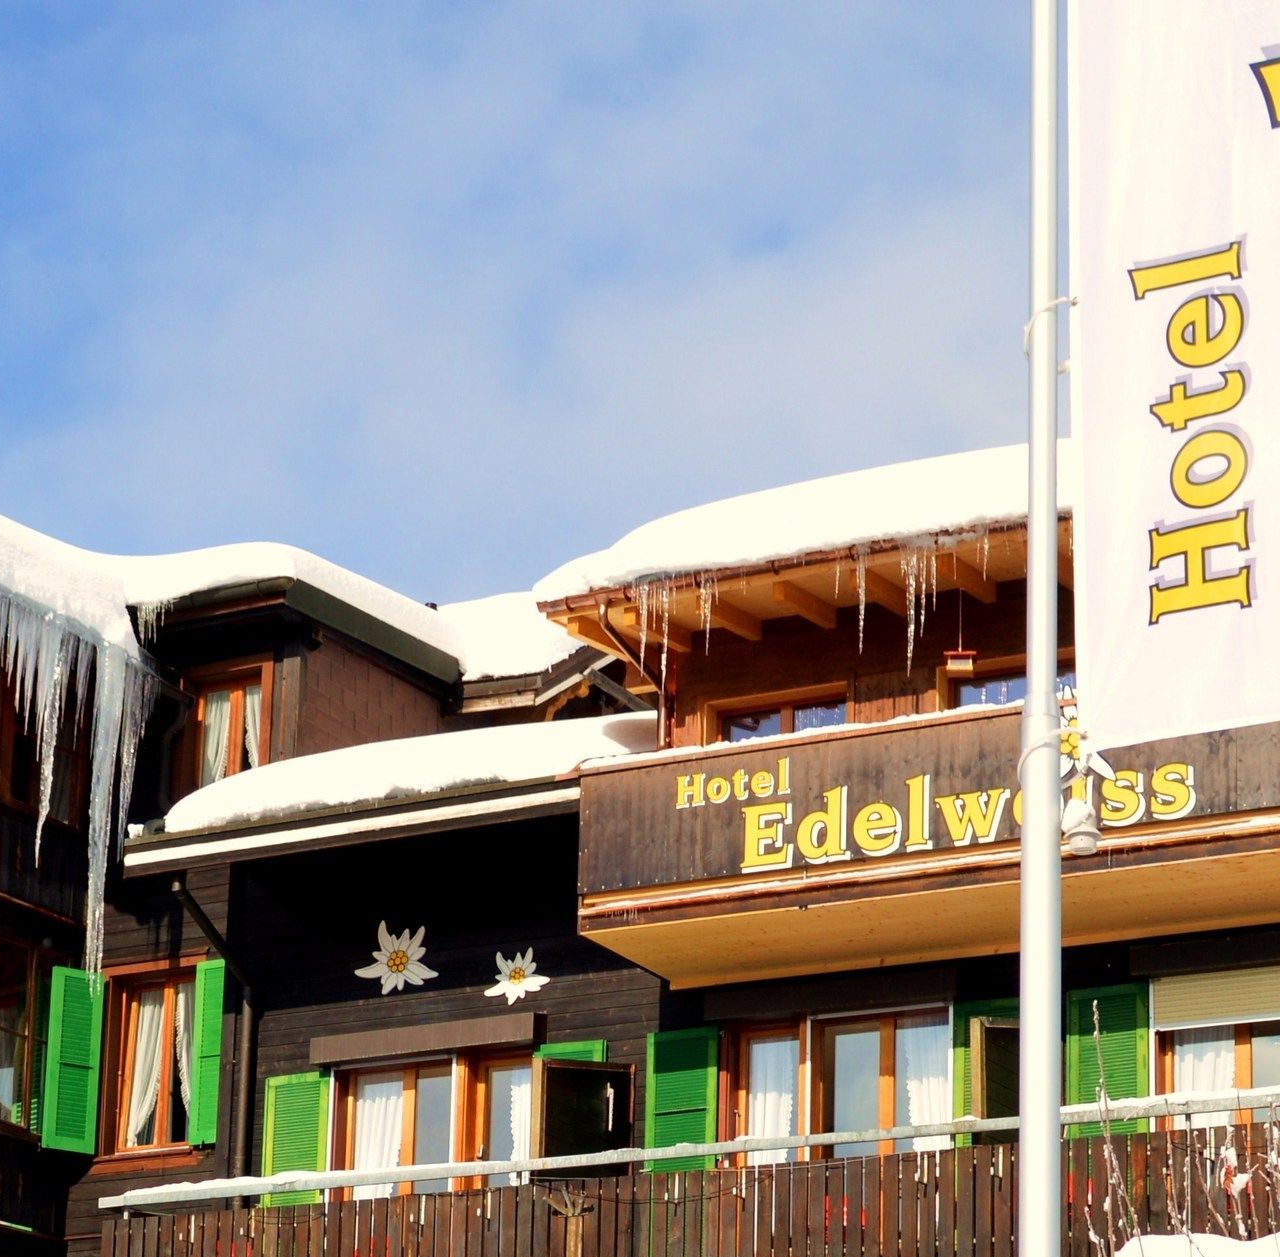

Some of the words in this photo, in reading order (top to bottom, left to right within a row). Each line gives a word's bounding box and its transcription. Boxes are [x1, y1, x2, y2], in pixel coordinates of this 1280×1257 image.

[1127, 236, 1254, 627] Hotel
[675, 757, 792, 810] Hotel
[739, 761, 1196, 874] Edelwiss
